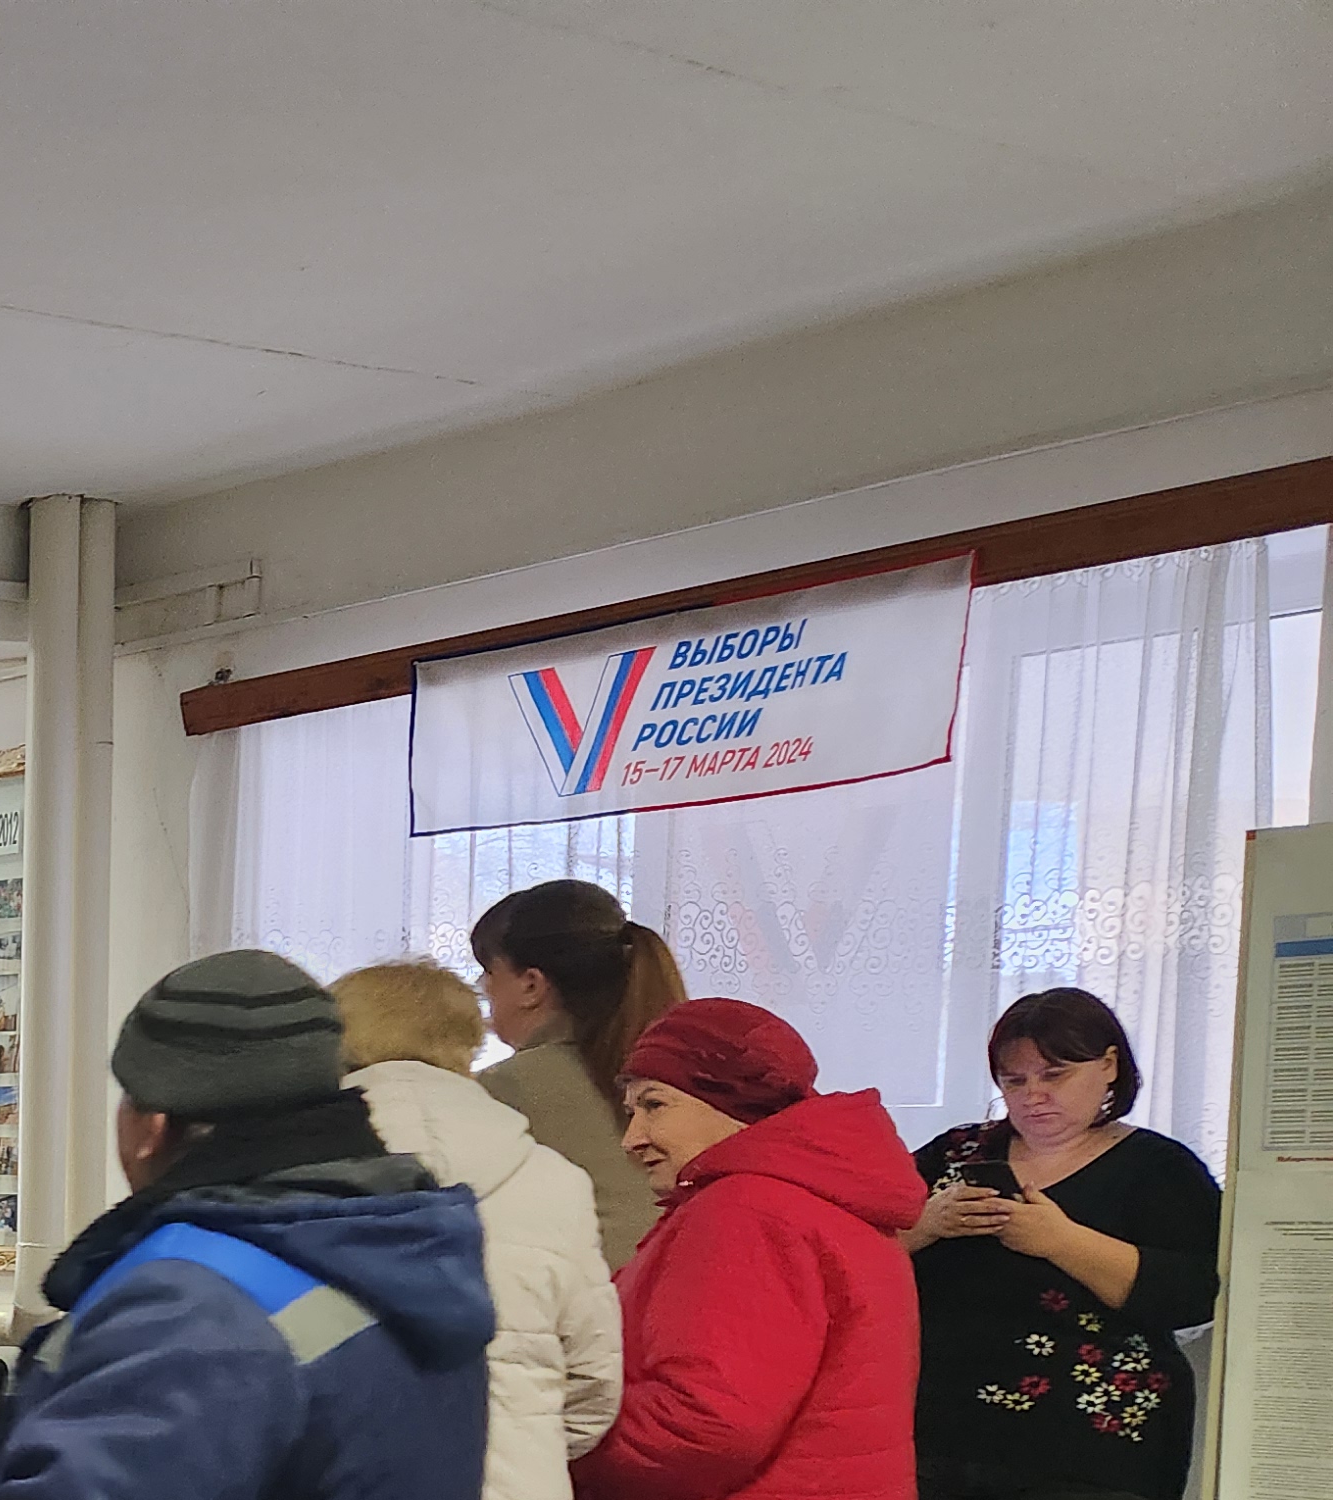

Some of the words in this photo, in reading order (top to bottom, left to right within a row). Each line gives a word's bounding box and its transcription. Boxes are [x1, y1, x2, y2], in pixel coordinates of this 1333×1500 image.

[668, 618, 807, 671] ВЫБОРЫ
[650, 651, 848, 711] ПРЕЗИДЕНТА
[631, 707, 764, 752] РОССИИ
[685, 745, 762, 779] МАРТА
[762, 736, 814, 769] 2024
